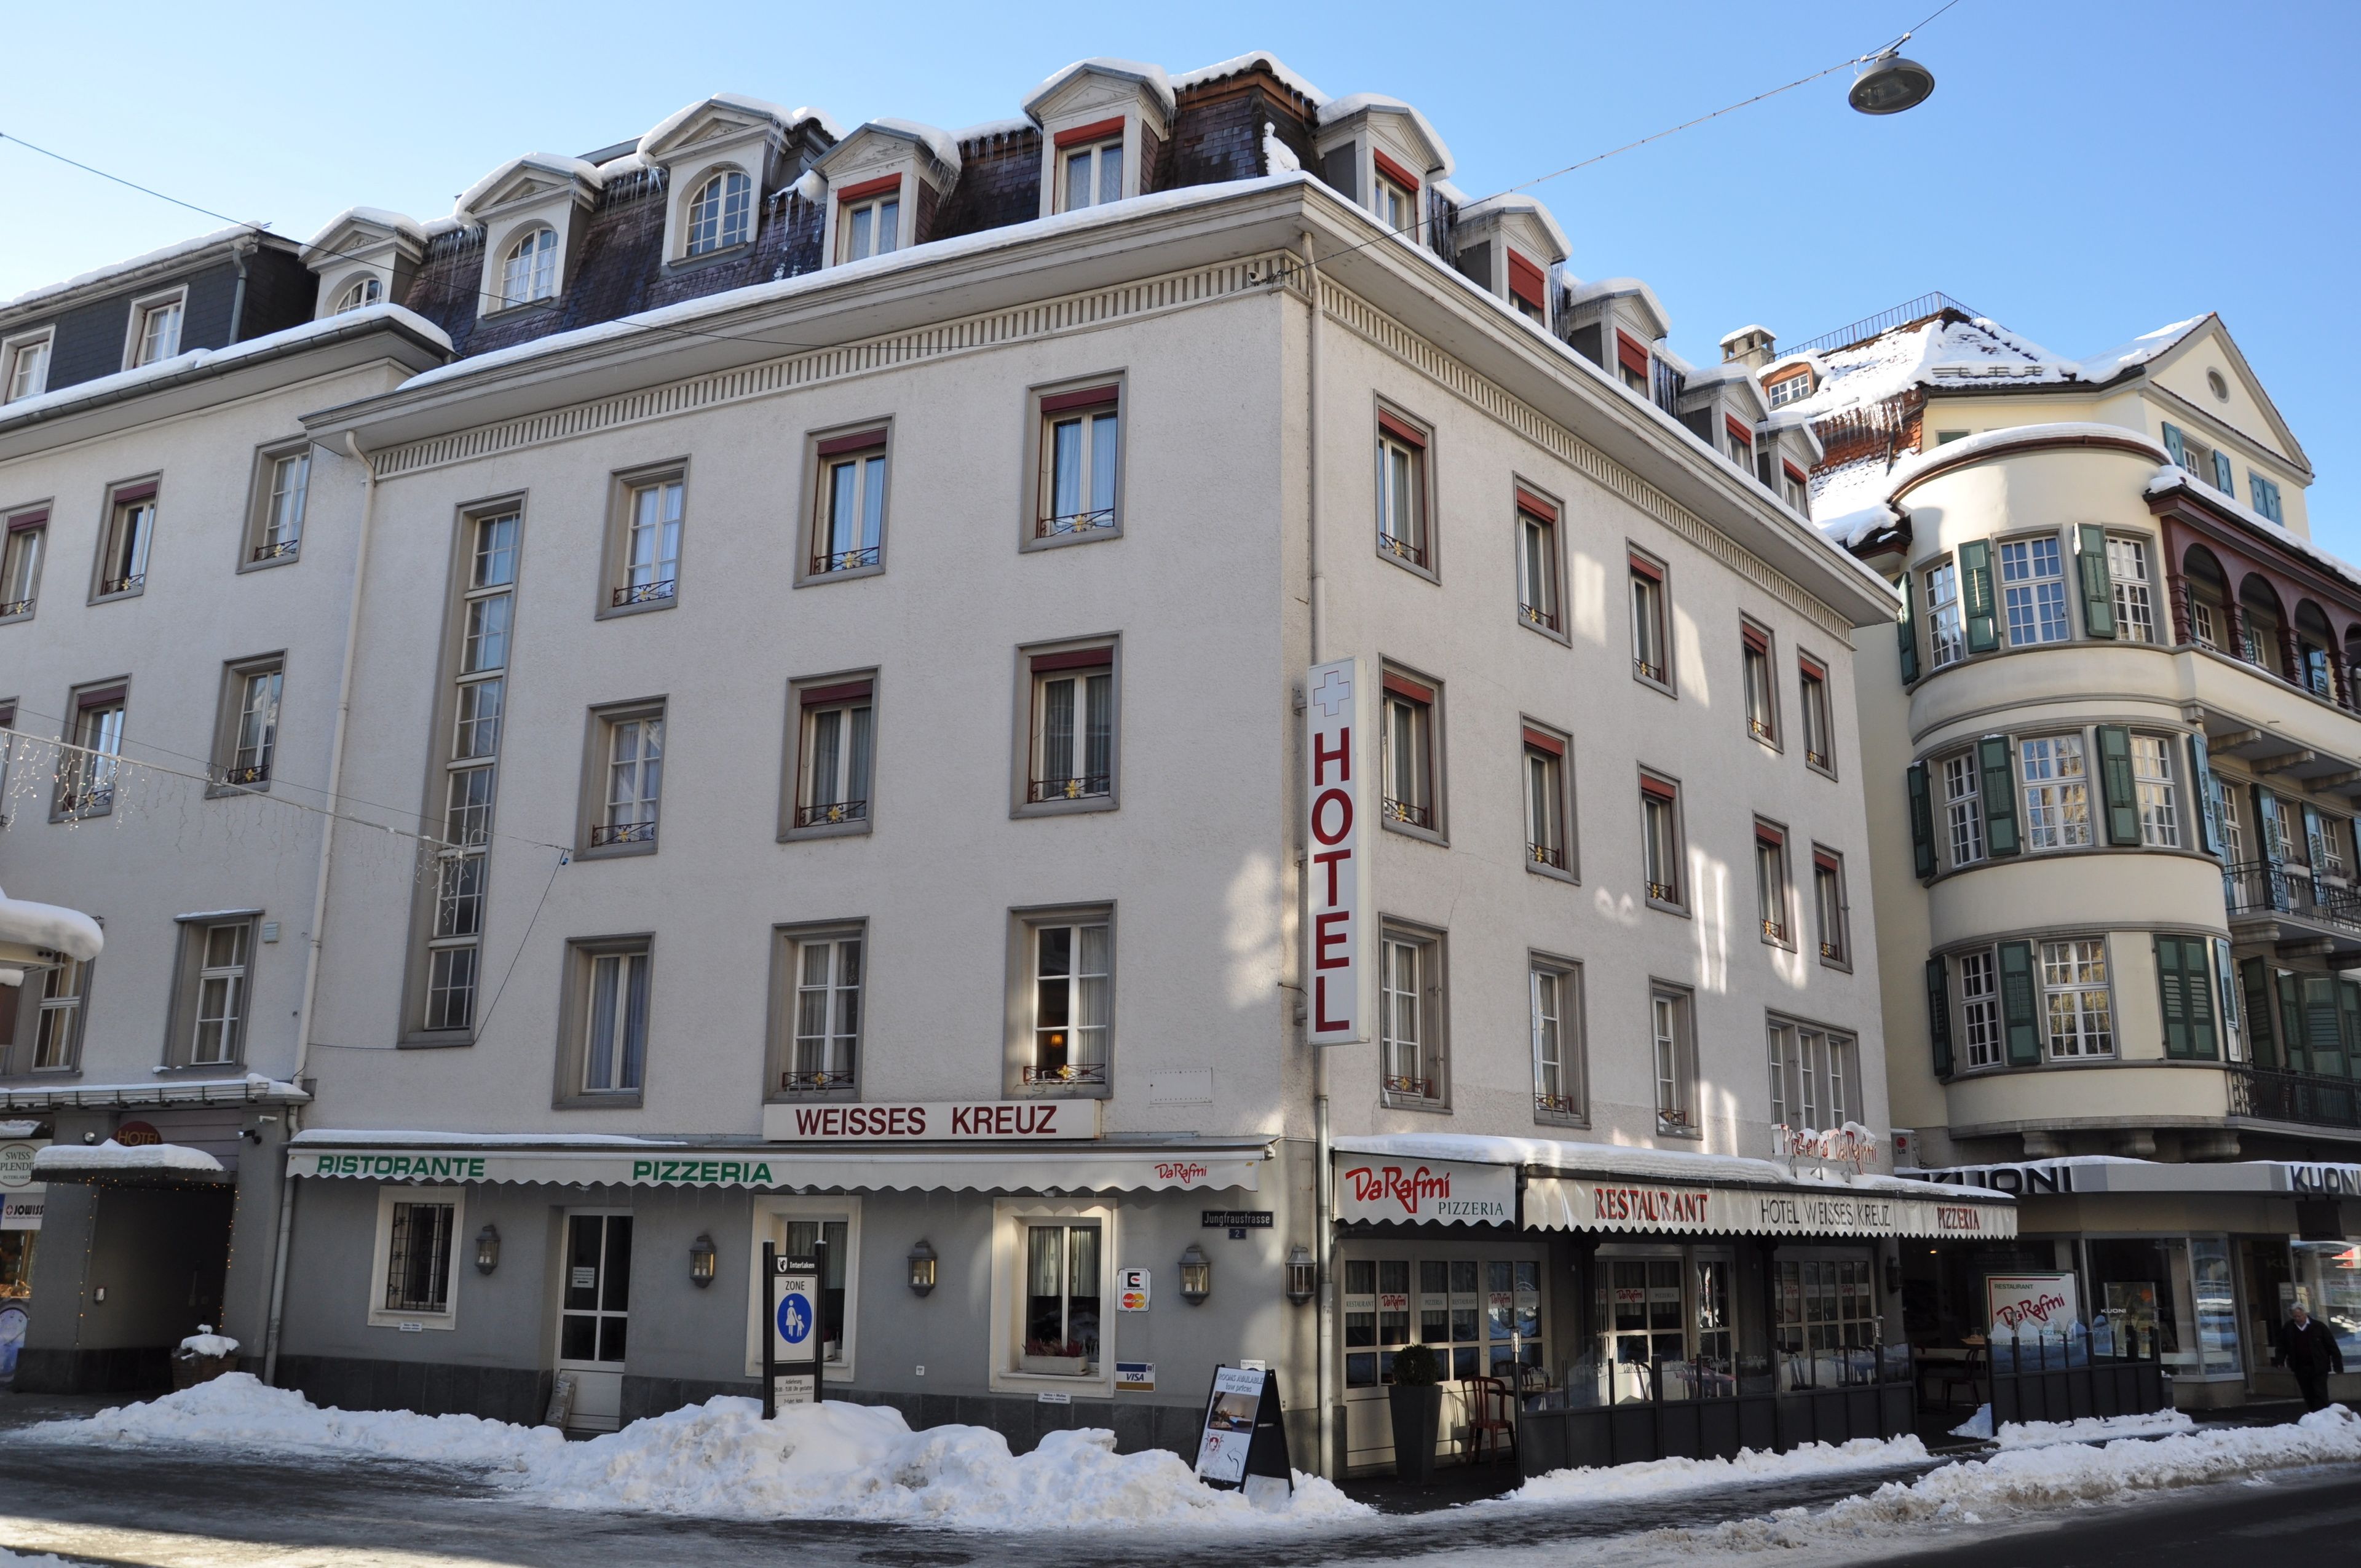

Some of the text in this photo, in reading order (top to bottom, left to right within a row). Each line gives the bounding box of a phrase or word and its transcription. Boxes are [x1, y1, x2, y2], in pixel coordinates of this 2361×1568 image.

[1311, 727, 1353, 1032] HOTEL
[796, 1105, 1058, 1136] WEISSES KREUZ
[6, 1151, 31, 1160] SWISS
[0, 1162, 35, 1171] PLENDI
[317, 1155, 484, 1177] RISTORANTE
[633, 1160, 773, 1184] PIZZERIA
[2290, 1165, 2361, 1194] KUONI
[14, 1205, 44, 1216] JOWISS
[1438, 1201, 1504, 1216] PIZZERIA
[1594, 1188, 1708, 1222] RESTAURANT
[1761, 1199, 1891, 1227] HOTEL WEISSES KREUZ
[1204, 1211, 1270, 1227] Jungfraustrasse
[1937, 1206, 1980, 1230] PIZZERIA
[785, 1281, 805, 1291] ZONE
[1126, 1372, 1144, 1382] VISA
[1218, 1372, 1264, 1384] ROOMS AVAILABLE
